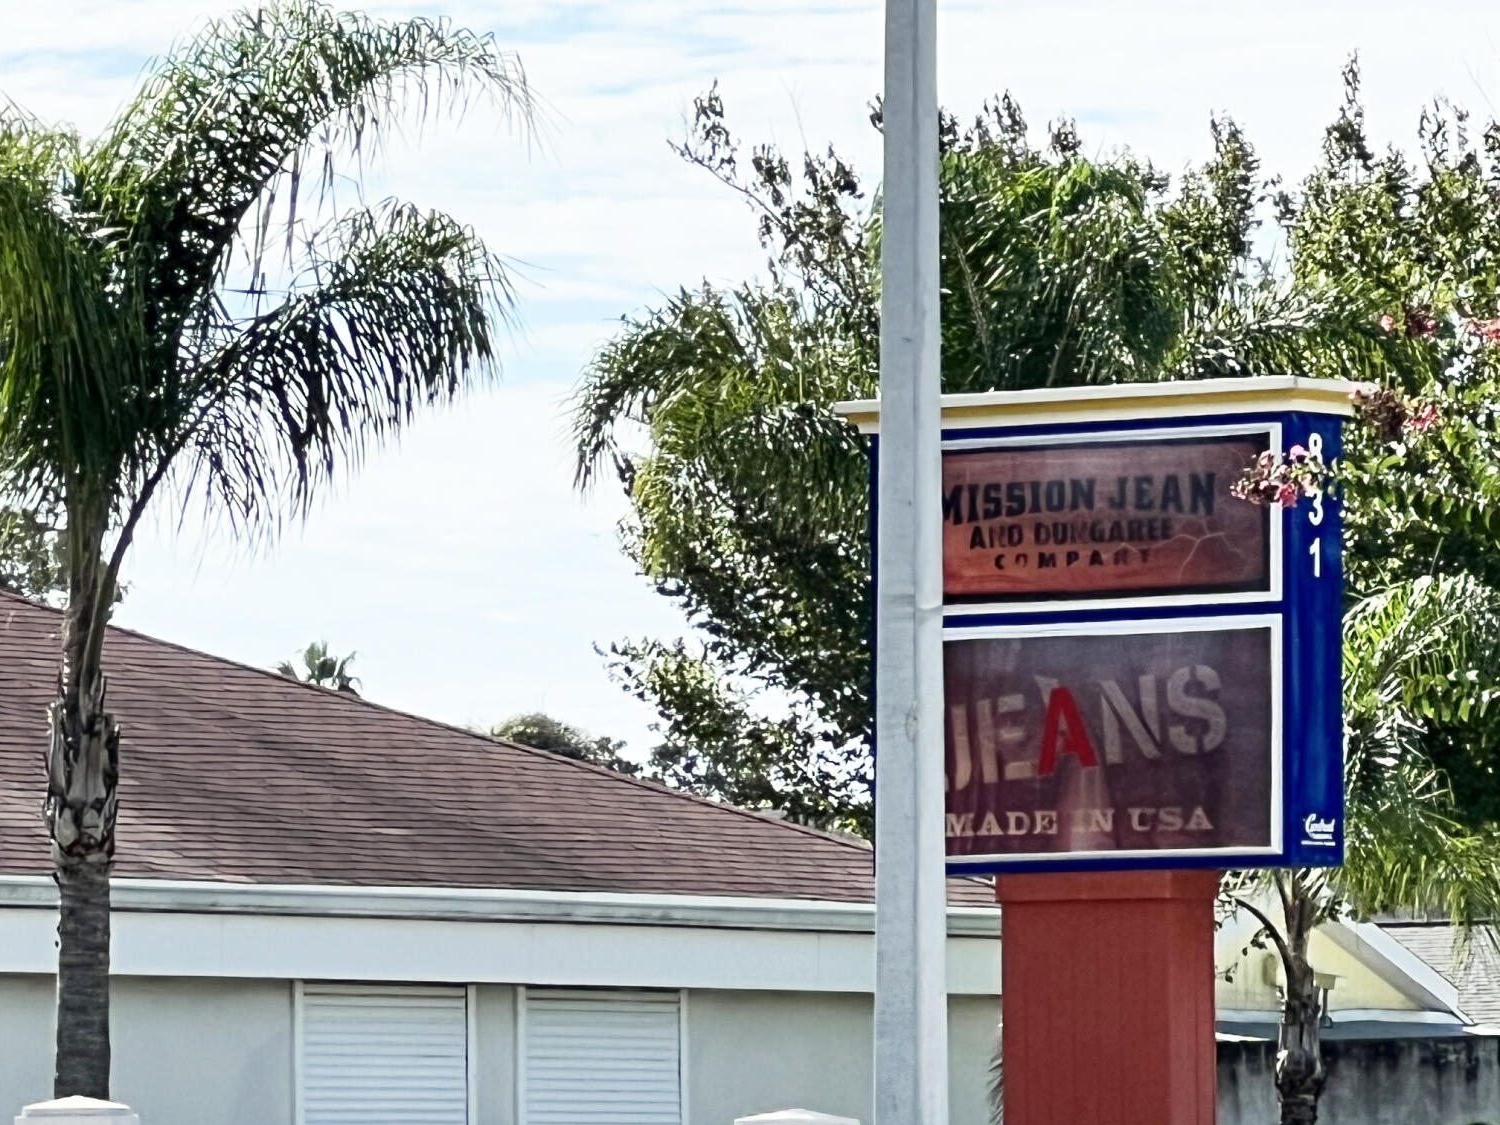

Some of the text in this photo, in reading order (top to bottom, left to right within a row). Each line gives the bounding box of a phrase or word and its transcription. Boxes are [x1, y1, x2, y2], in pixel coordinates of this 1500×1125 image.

[942, 472, 1216, 525] MISSION JEAN
[970, 517, 1174, 549] AND DUNGAREE
[943, 664, 1227, 791] JEANS
[945, 807, 1214, 837] MADE IN USA
